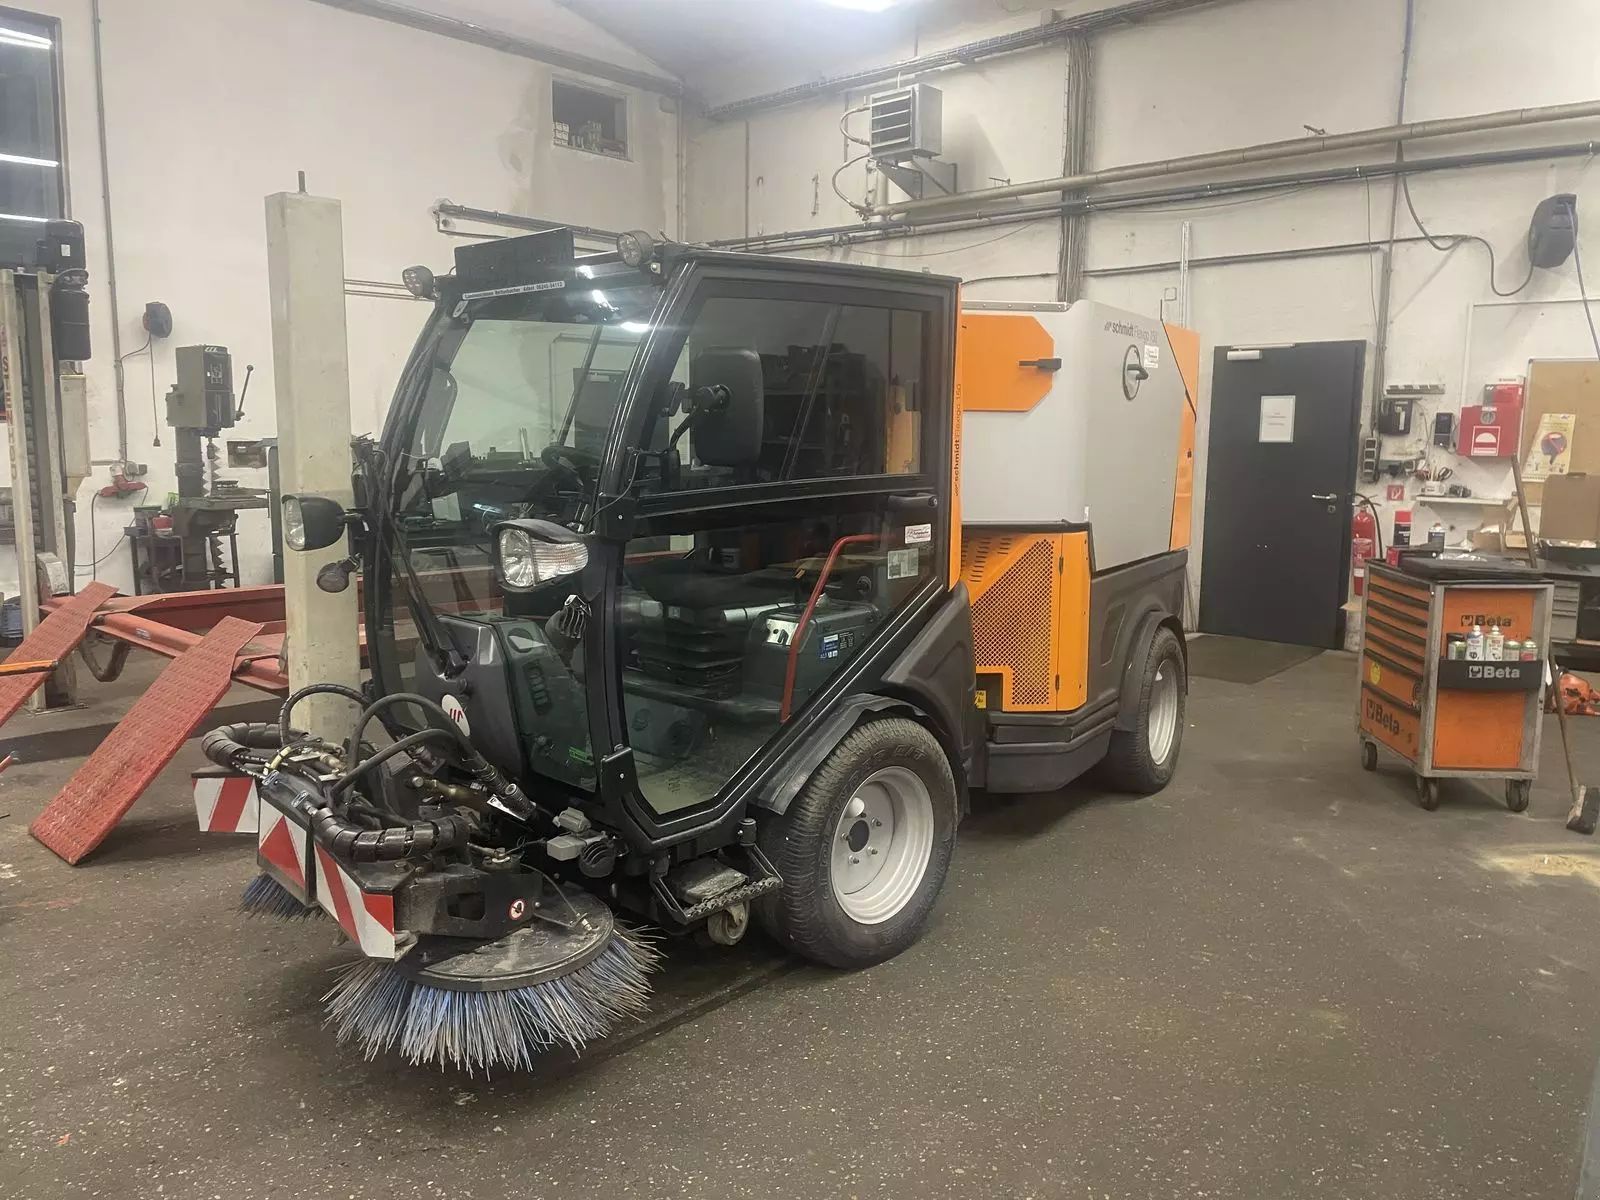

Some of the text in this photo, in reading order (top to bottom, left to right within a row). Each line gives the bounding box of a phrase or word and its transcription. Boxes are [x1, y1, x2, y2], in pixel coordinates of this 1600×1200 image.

[1112, 320, 1134, 337] schmidt
[953, 439, 961, 483] schmidt
[1475, 614, 1512, 627] Beta
[1483, 665, 1521, 679] Beta
[1375, 702, 1400, 736] Beta
